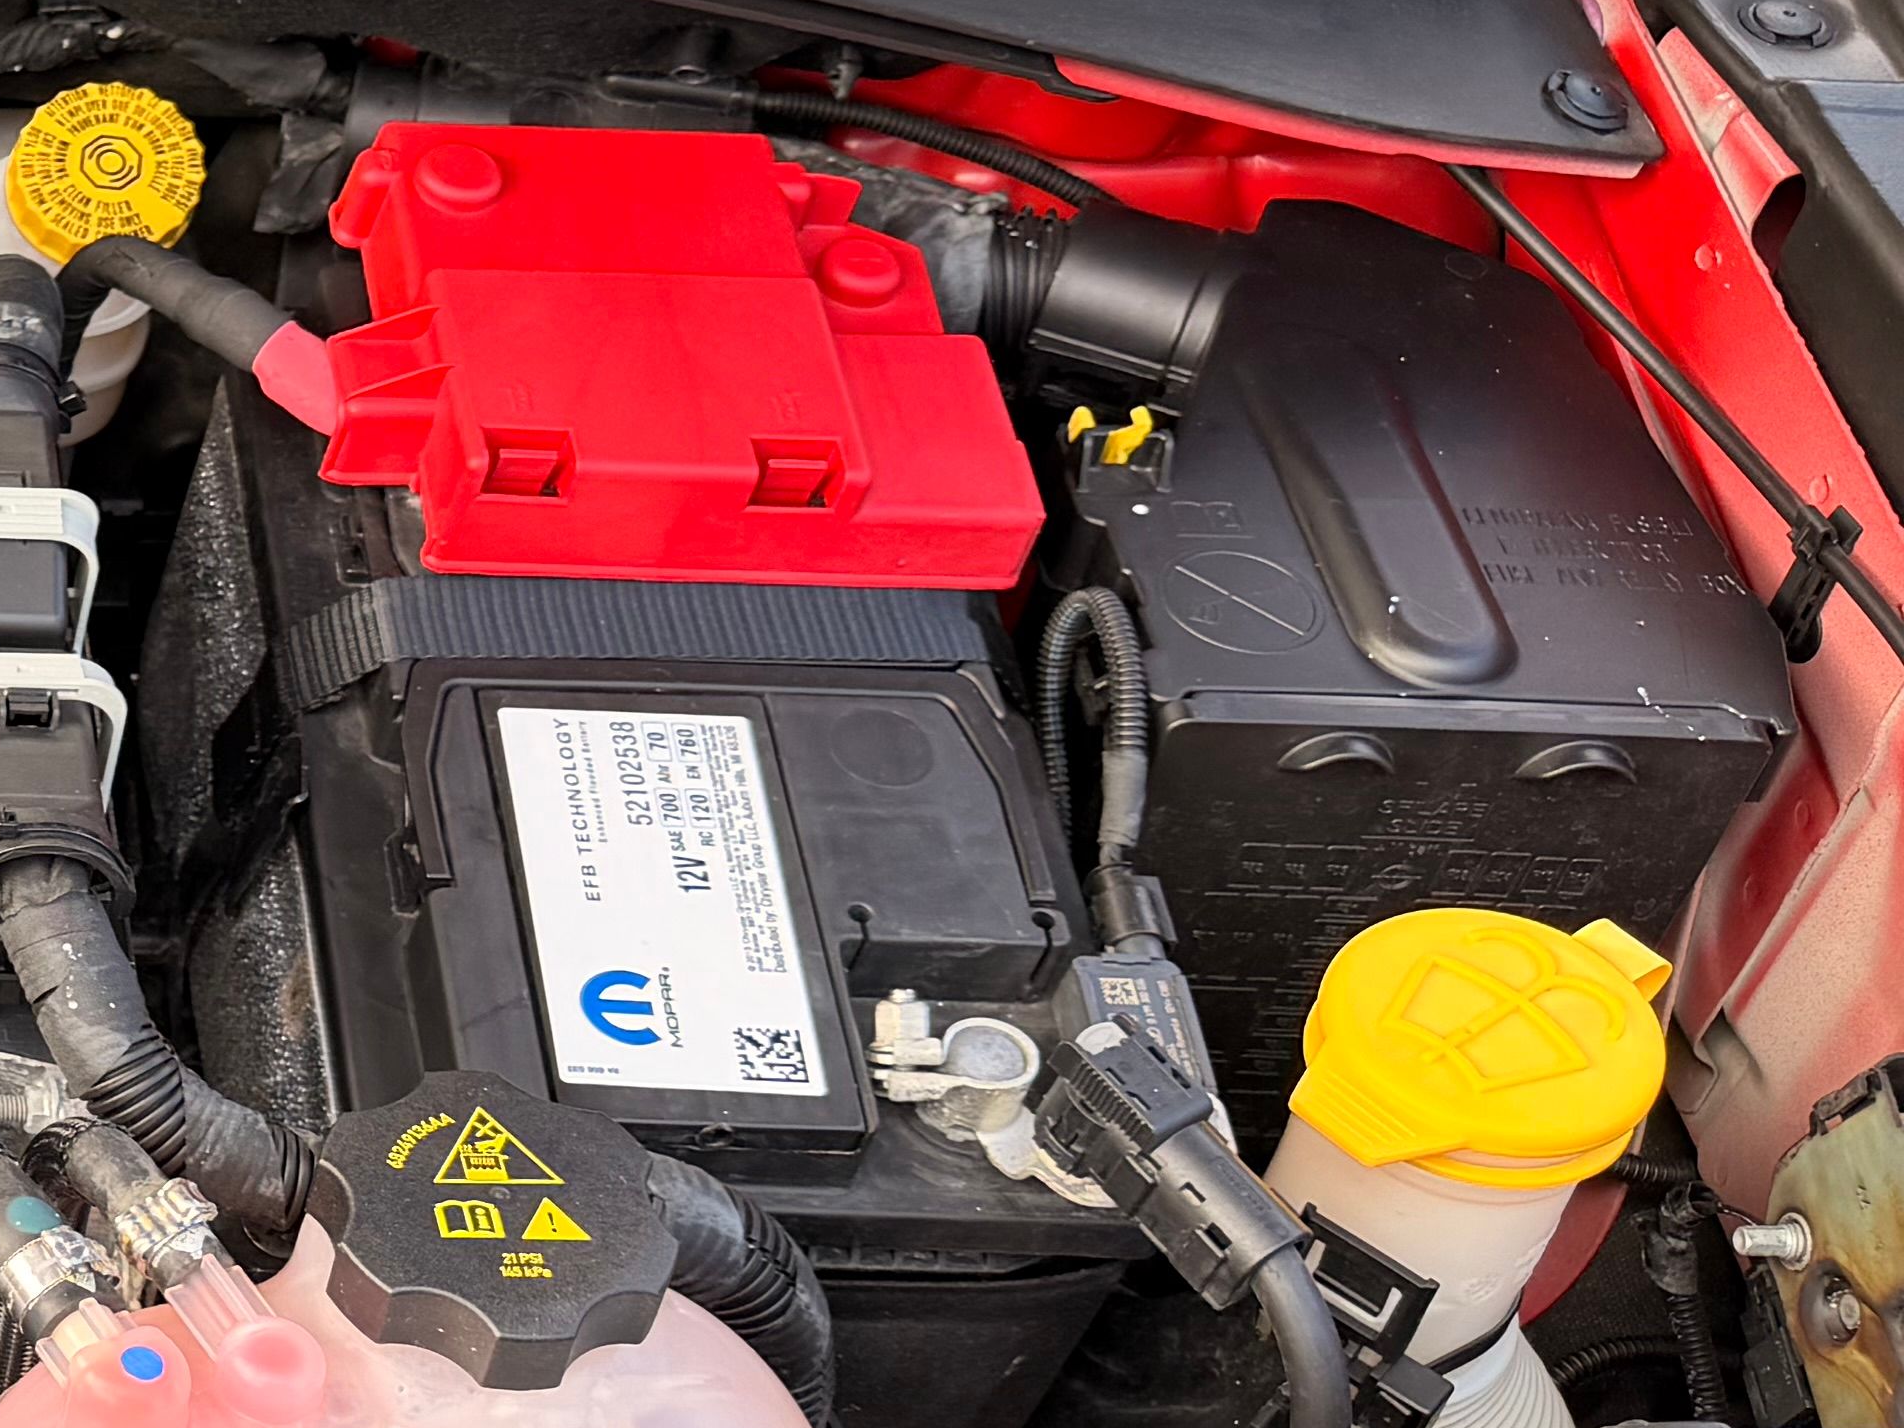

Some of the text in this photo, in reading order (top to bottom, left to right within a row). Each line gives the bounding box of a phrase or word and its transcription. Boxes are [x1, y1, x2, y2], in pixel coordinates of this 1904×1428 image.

[647, 732, 667, 750] 70
[610, 722, 652, 824] 52102538
[678, 730, 716, 845] RC 120 EN 760
[554, 718, 601, 900] EFB TECHNOLOGY
[659, 793, 682, 821] 700
[668, 831, 686, 850] SAE
[673, 856, 711, 892] 12V
[501, 1252, 545, 1265] 21 PSI
